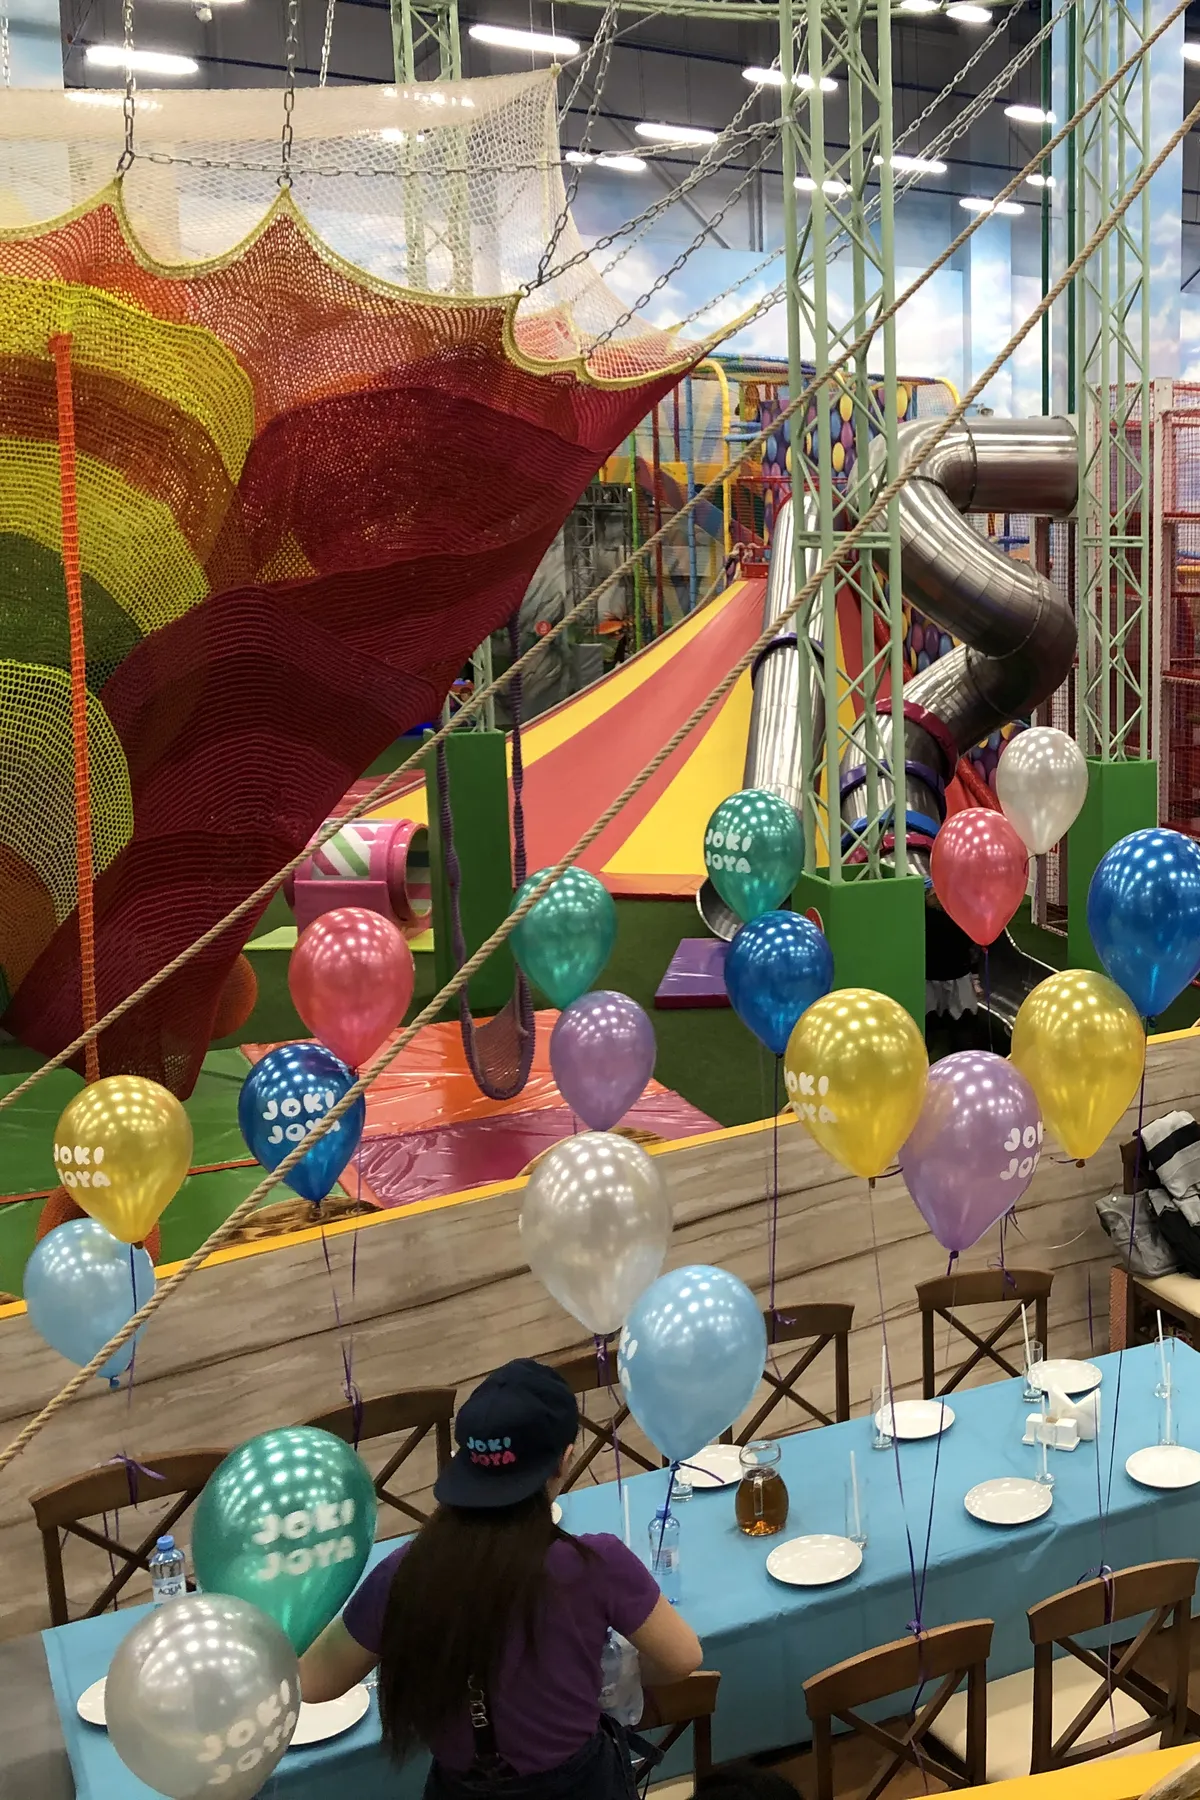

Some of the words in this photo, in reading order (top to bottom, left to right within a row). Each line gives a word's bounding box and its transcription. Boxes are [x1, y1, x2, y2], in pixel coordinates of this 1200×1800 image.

[783, 1066, 829, 1097] OKI
[262, 1090, 334, 1121] JOKI
[791, 1101, 839, 1123] OYA
[1003, 1120, 1043, 1152] JO
[1000, 1152, 1040, 1180] JO
[467, 1436, 511, 1452] JOKI
[470, 1451, 516, 1466] JOYA
[252, 1498, 354, 1545] JOKI
[257, 1535, 355, 1581] JOYA
[197, 1678, 290, 1763] JOKI
